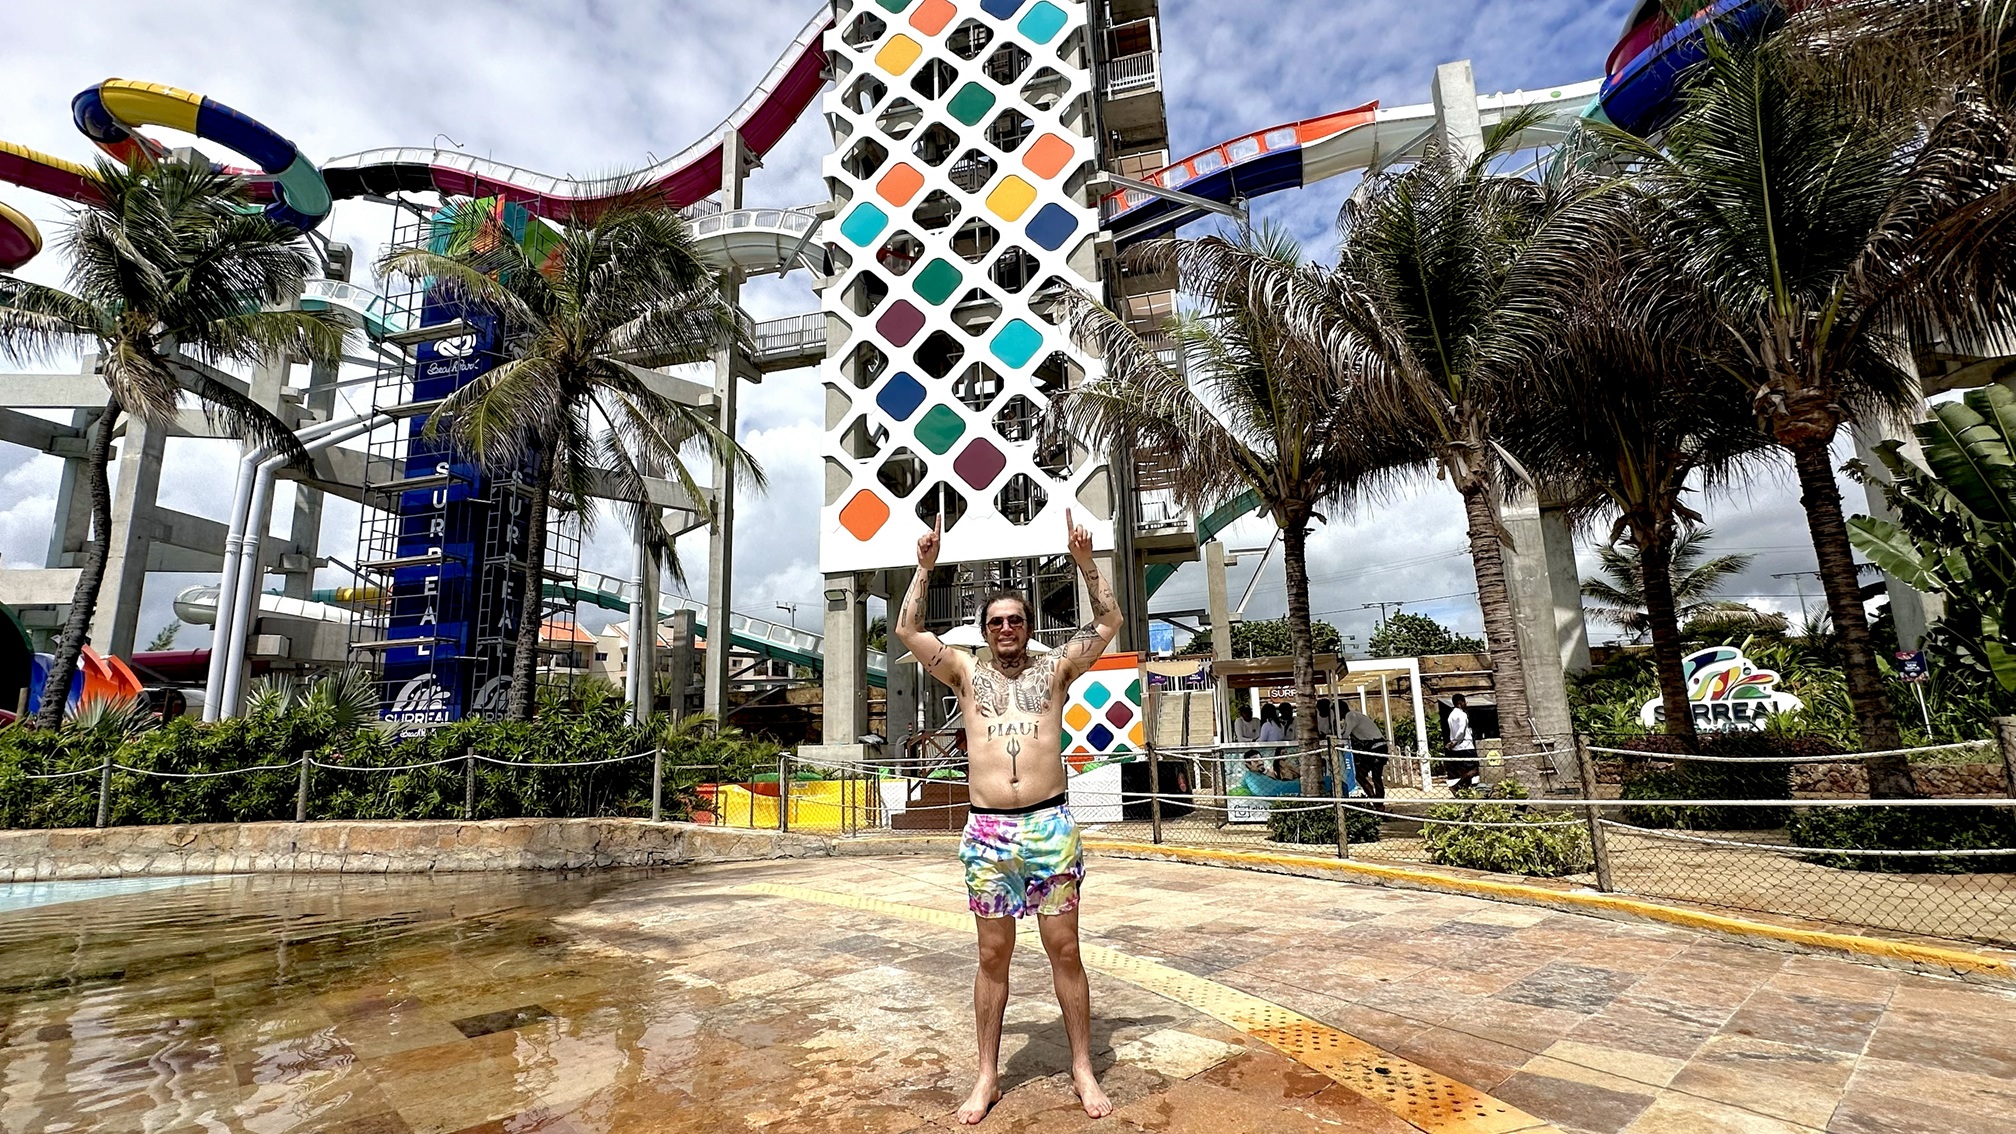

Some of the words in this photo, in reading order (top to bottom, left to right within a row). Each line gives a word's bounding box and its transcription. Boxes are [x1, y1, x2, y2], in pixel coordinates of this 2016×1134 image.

[1271, 689, 1298, 698] SURR
[1653, 701, 1780, 726] SRREA
[987, 720, 1040, 742] PIAUÍ
